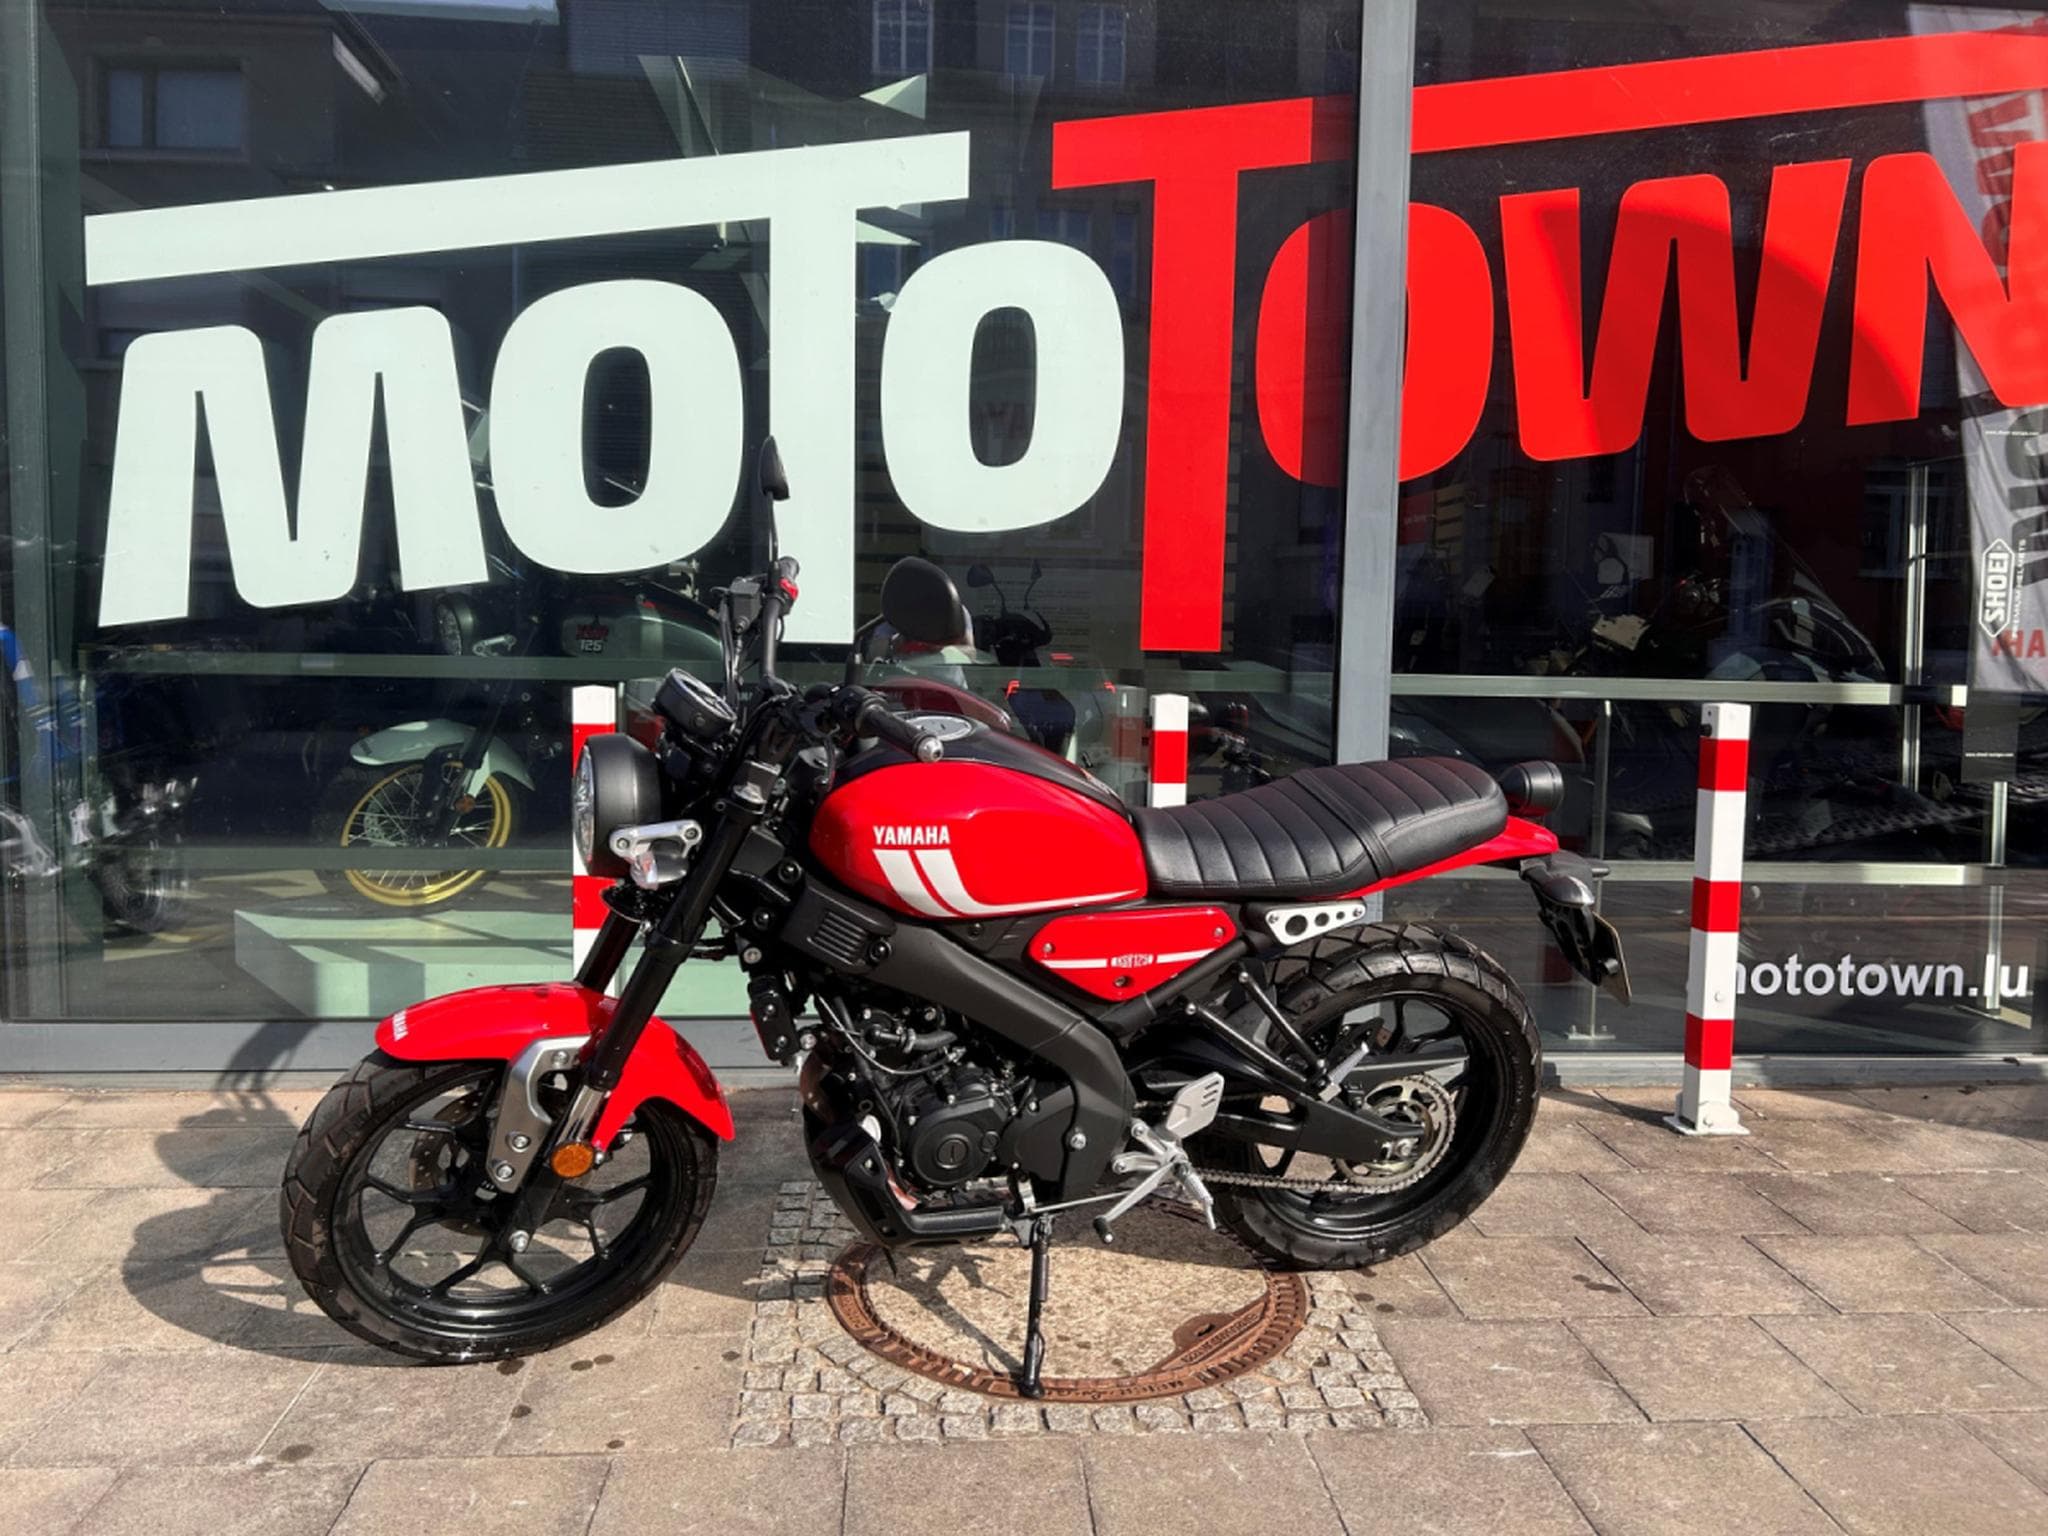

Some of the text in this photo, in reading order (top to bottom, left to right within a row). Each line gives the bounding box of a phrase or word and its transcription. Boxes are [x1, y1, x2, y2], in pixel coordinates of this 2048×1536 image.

[1984, 552, 2010, 623] SHOEI
[580, 639, 603, 652] 125
[873, 825, 950, 845] YAMAHA
[1734, 953, 2028, 997] ototown.lu
